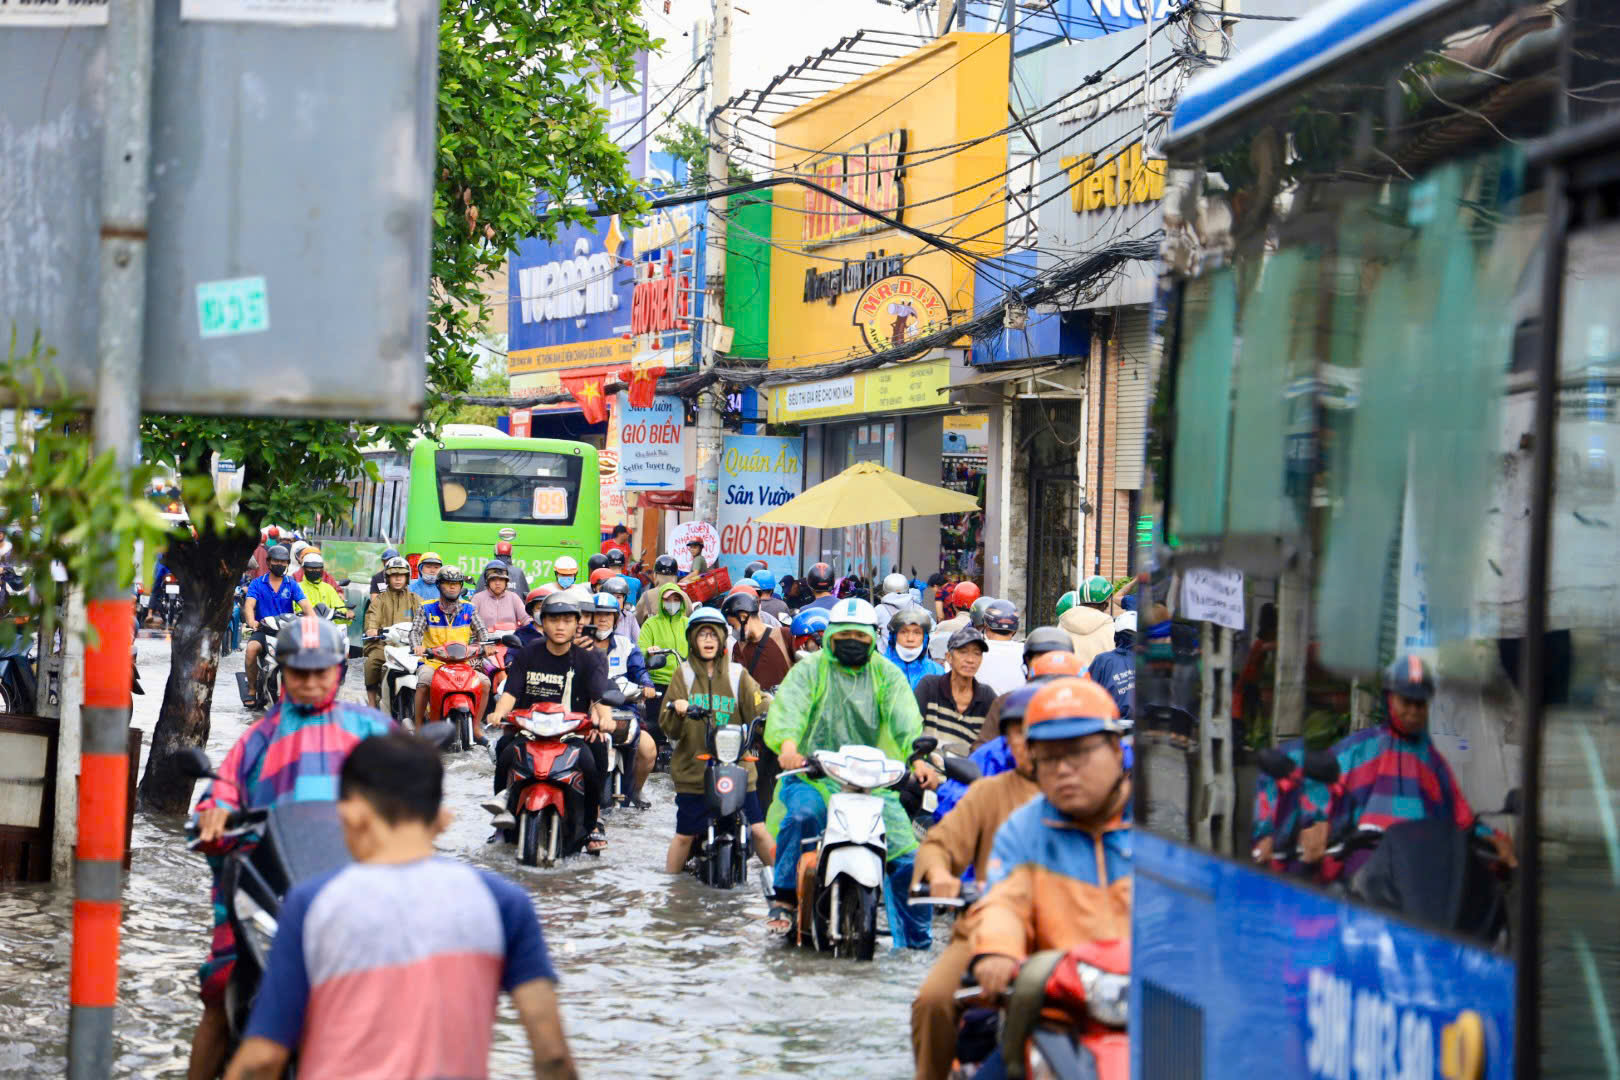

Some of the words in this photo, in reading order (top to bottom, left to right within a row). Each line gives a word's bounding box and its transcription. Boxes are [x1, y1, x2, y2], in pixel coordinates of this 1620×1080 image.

[621, 418, 647, 444] GIÓ
[649, 415, 681, 445] BIỂN
[725, 447, 770, 477] Quán
[774, 444, 799, 474] Ăn
[537, 492, 565, 515] 89
[725, 484, 754, 505] Sân
[720, 515, 753, 556] GIÓ
